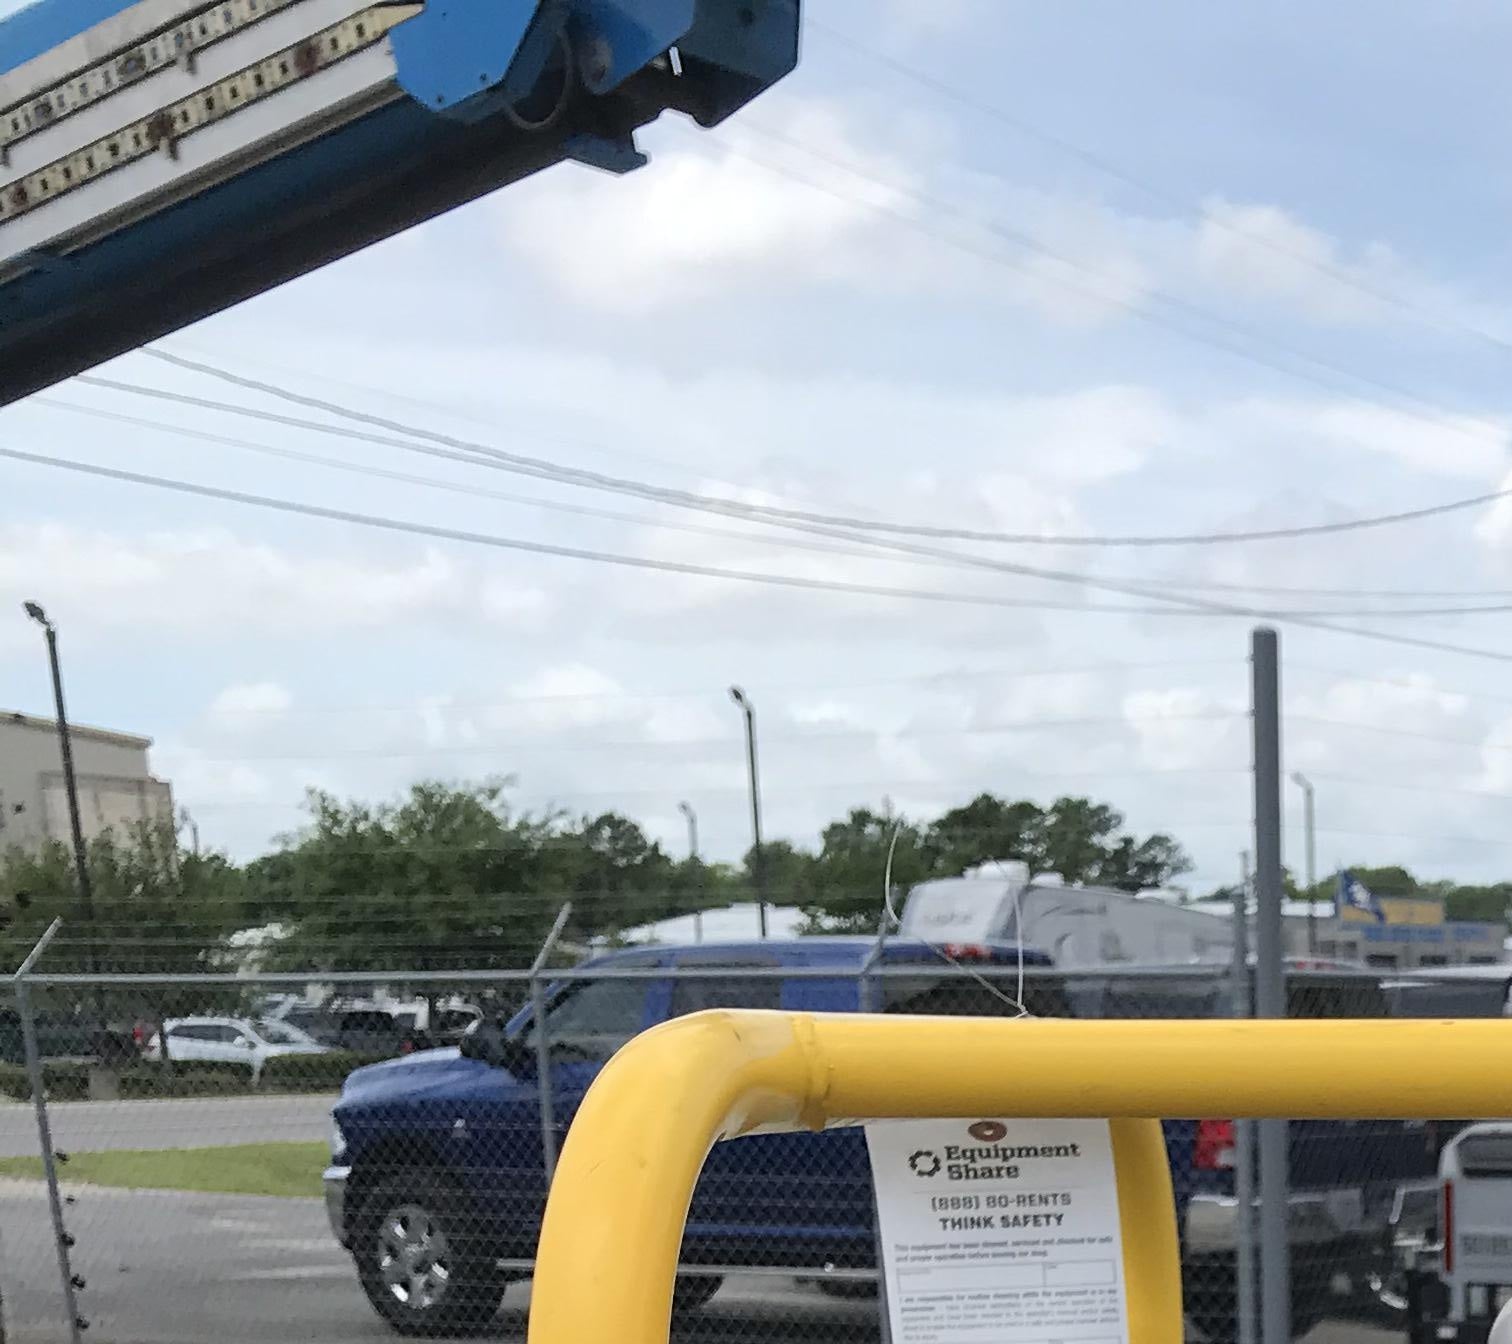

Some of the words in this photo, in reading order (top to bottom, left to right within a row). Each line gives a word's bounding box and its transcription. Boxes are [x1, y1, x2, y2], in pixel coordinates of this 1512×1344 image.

[944, 1143, 1081, 1162] Equipment
[947, 1164, 1020, 1180] Share
[986, 1192, 1072, 1208] 80-RENTS
[939, 1216, 995, 1231] THINK
[1000, 1213, 1064, 1229] SAFETY
